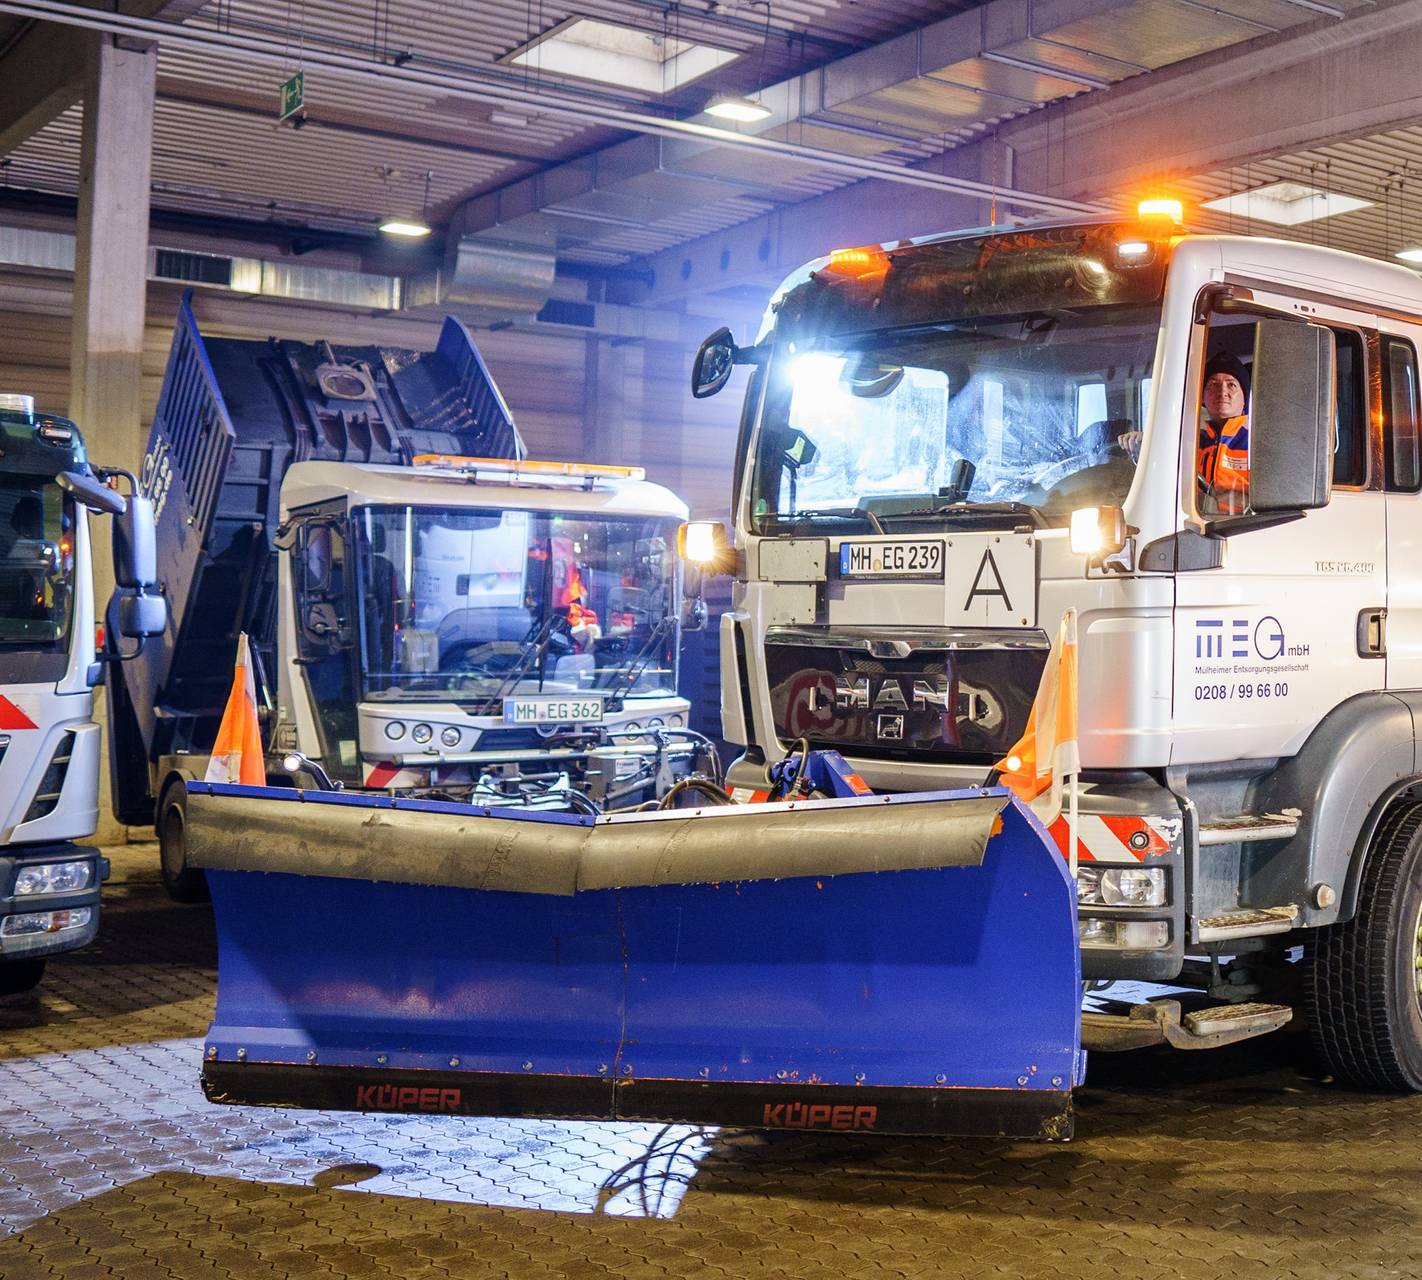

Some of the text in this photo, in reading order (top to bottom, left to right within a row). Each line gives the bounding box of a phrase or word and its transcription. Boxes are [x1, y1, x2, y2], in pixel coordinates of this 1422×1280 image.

[850, 547, 872, 570] MH
[882, 546, 904, 570] EG
[908, 545, 940, 570] 239
[963, 548, 1014, 612] A
[1287, 645, 1310, 656] mbH
[1195, 664, 1309, 674] Mülheimer Entsorgungsgesellschaft
[834, 676, 950, 712] MAN
[1195, 682, 1289, 700] 0208 / 99 66 00
[516, 703, 537, 719] MH
[547, 703, 568, 719] EG
[571, 702, 600, 718] 362
[356, 1084, 461, 1111] KÜPER
[762, 1102, 878, 1130] KÜPER
